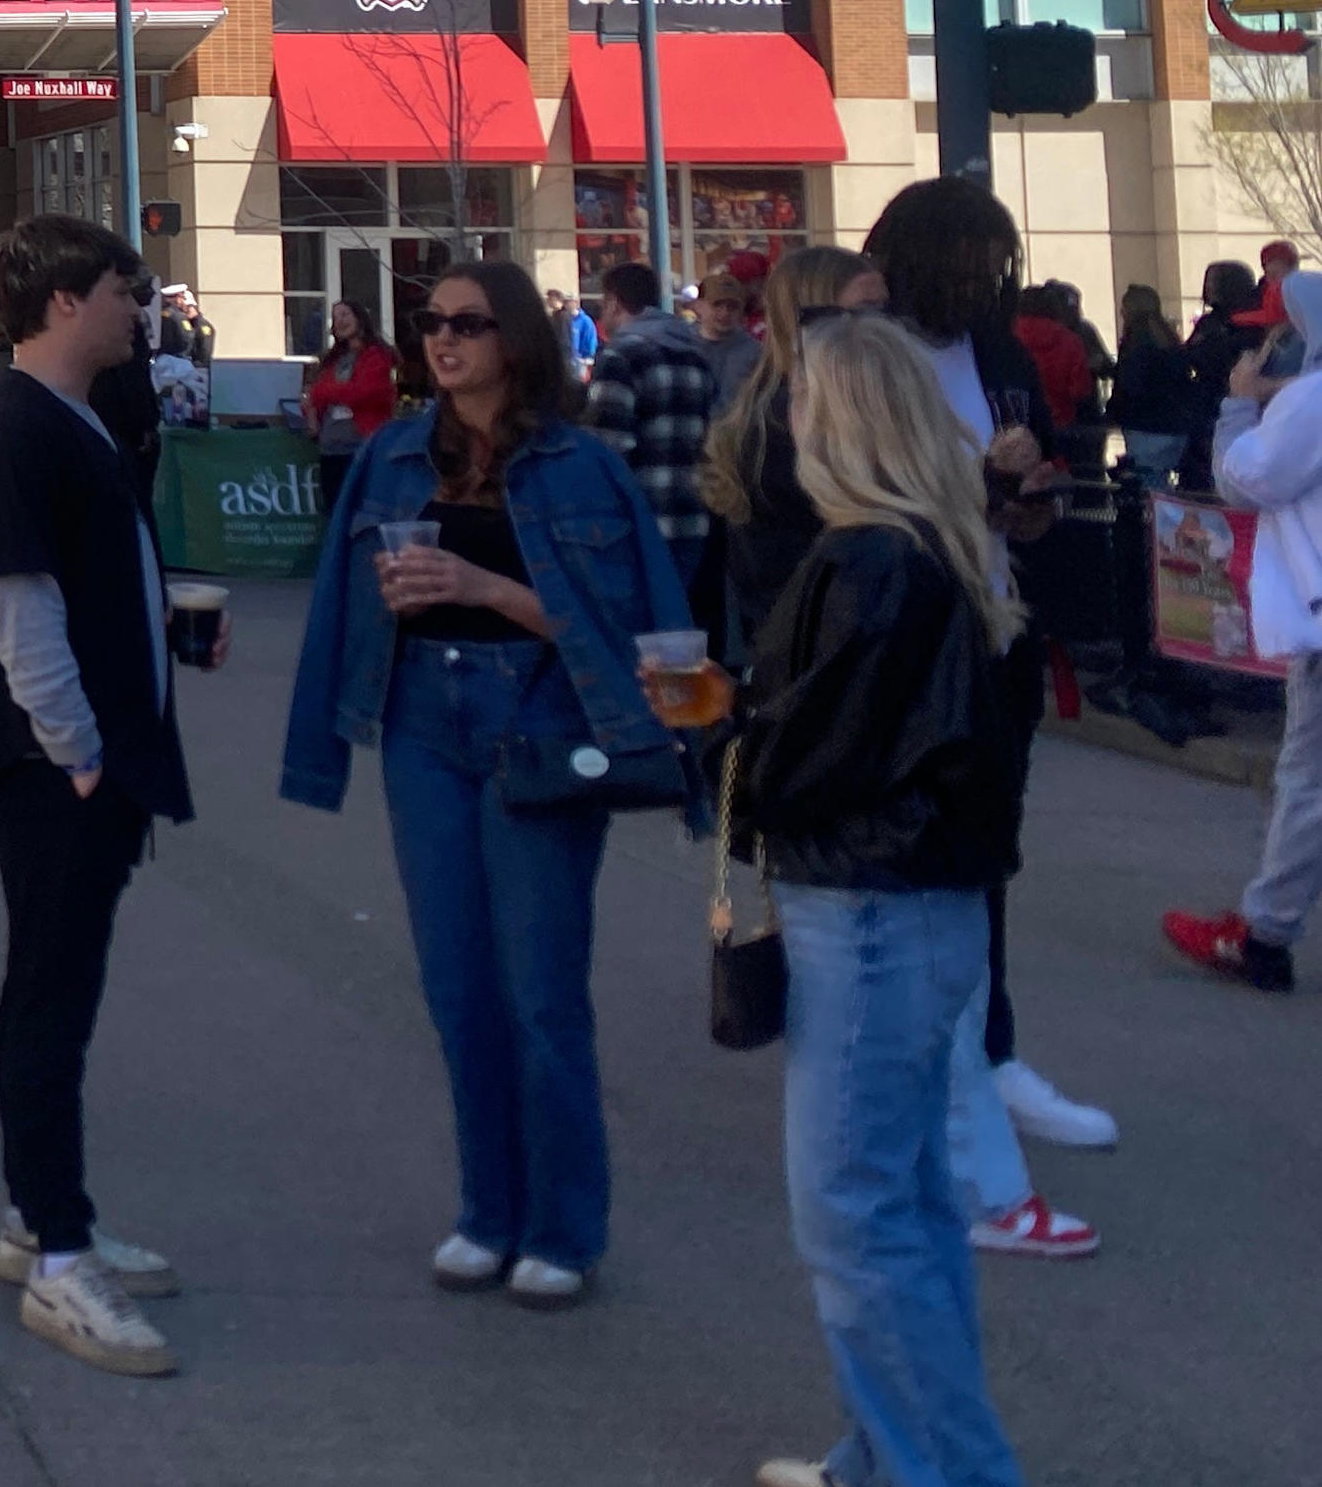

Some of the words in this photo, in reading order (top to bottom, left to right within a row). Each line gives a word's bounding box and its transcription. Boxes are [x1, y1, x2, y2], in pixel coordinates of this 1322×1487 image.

[9, 80, 32, 96] Joe
[35, 80, 83, 96] Nuxhall
[86, 80, 113, 98] Way
[218, 463, 321, 516] asdf
